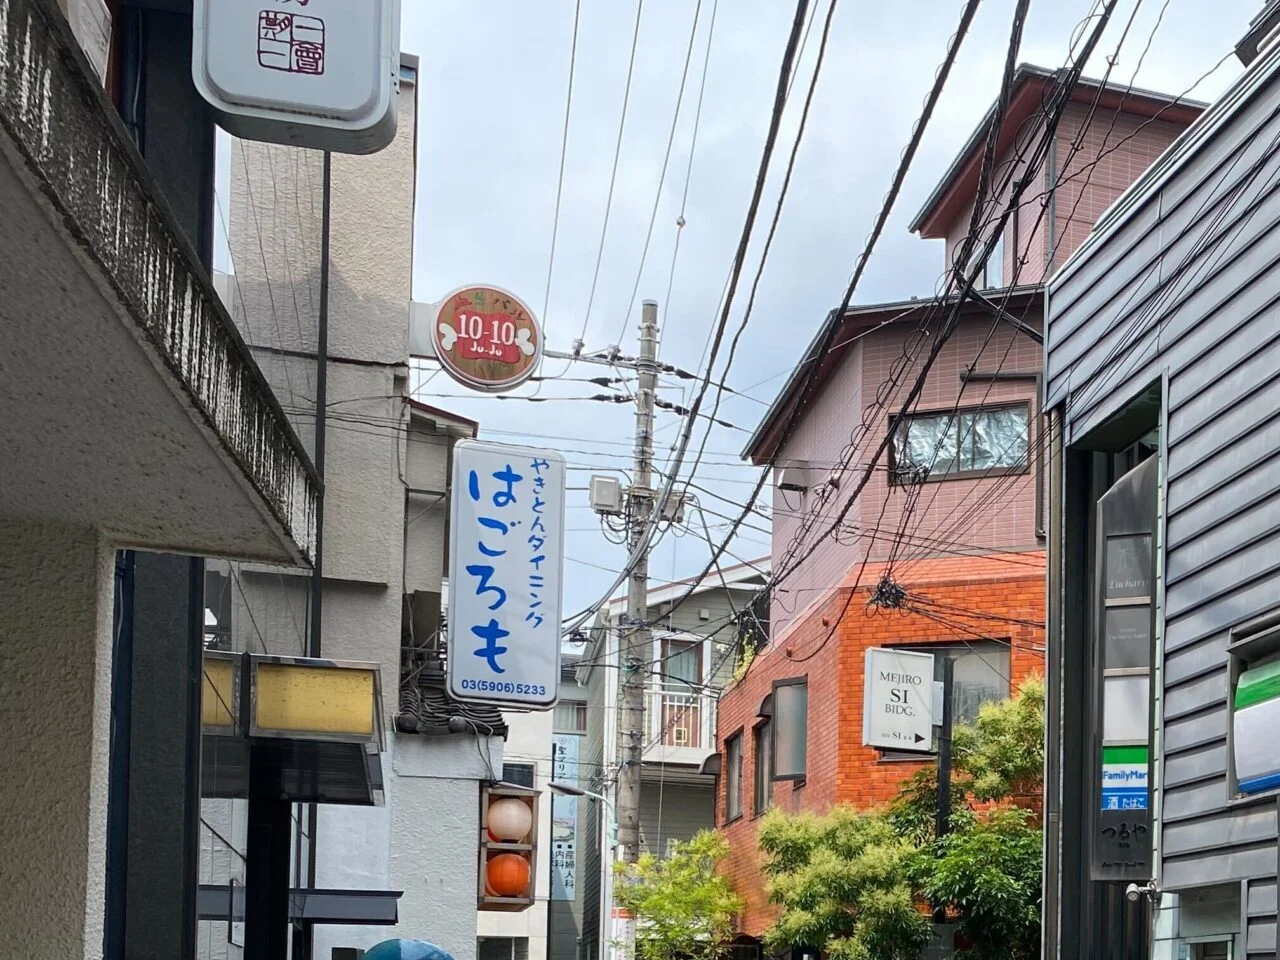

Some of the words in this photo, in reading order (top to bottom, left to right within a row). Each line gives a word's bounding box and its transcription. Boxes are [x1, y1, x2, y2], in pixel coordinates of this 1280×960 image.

[458, 313, 515, 346] 10-10
[525, 457, 550, 629] やきとんダイニング
[466, 464, 524, 674] はごろも
[461, 678, 547, 696] 03(5906)5233
[880, 671, 922, 686] MEJIRO
[890, 688, 909, 704] SI
[1107, 796, 1119, 809] 酒
[555, 851, 565, 868] 内科
[564, 850, 575, 888] 産婦人科
